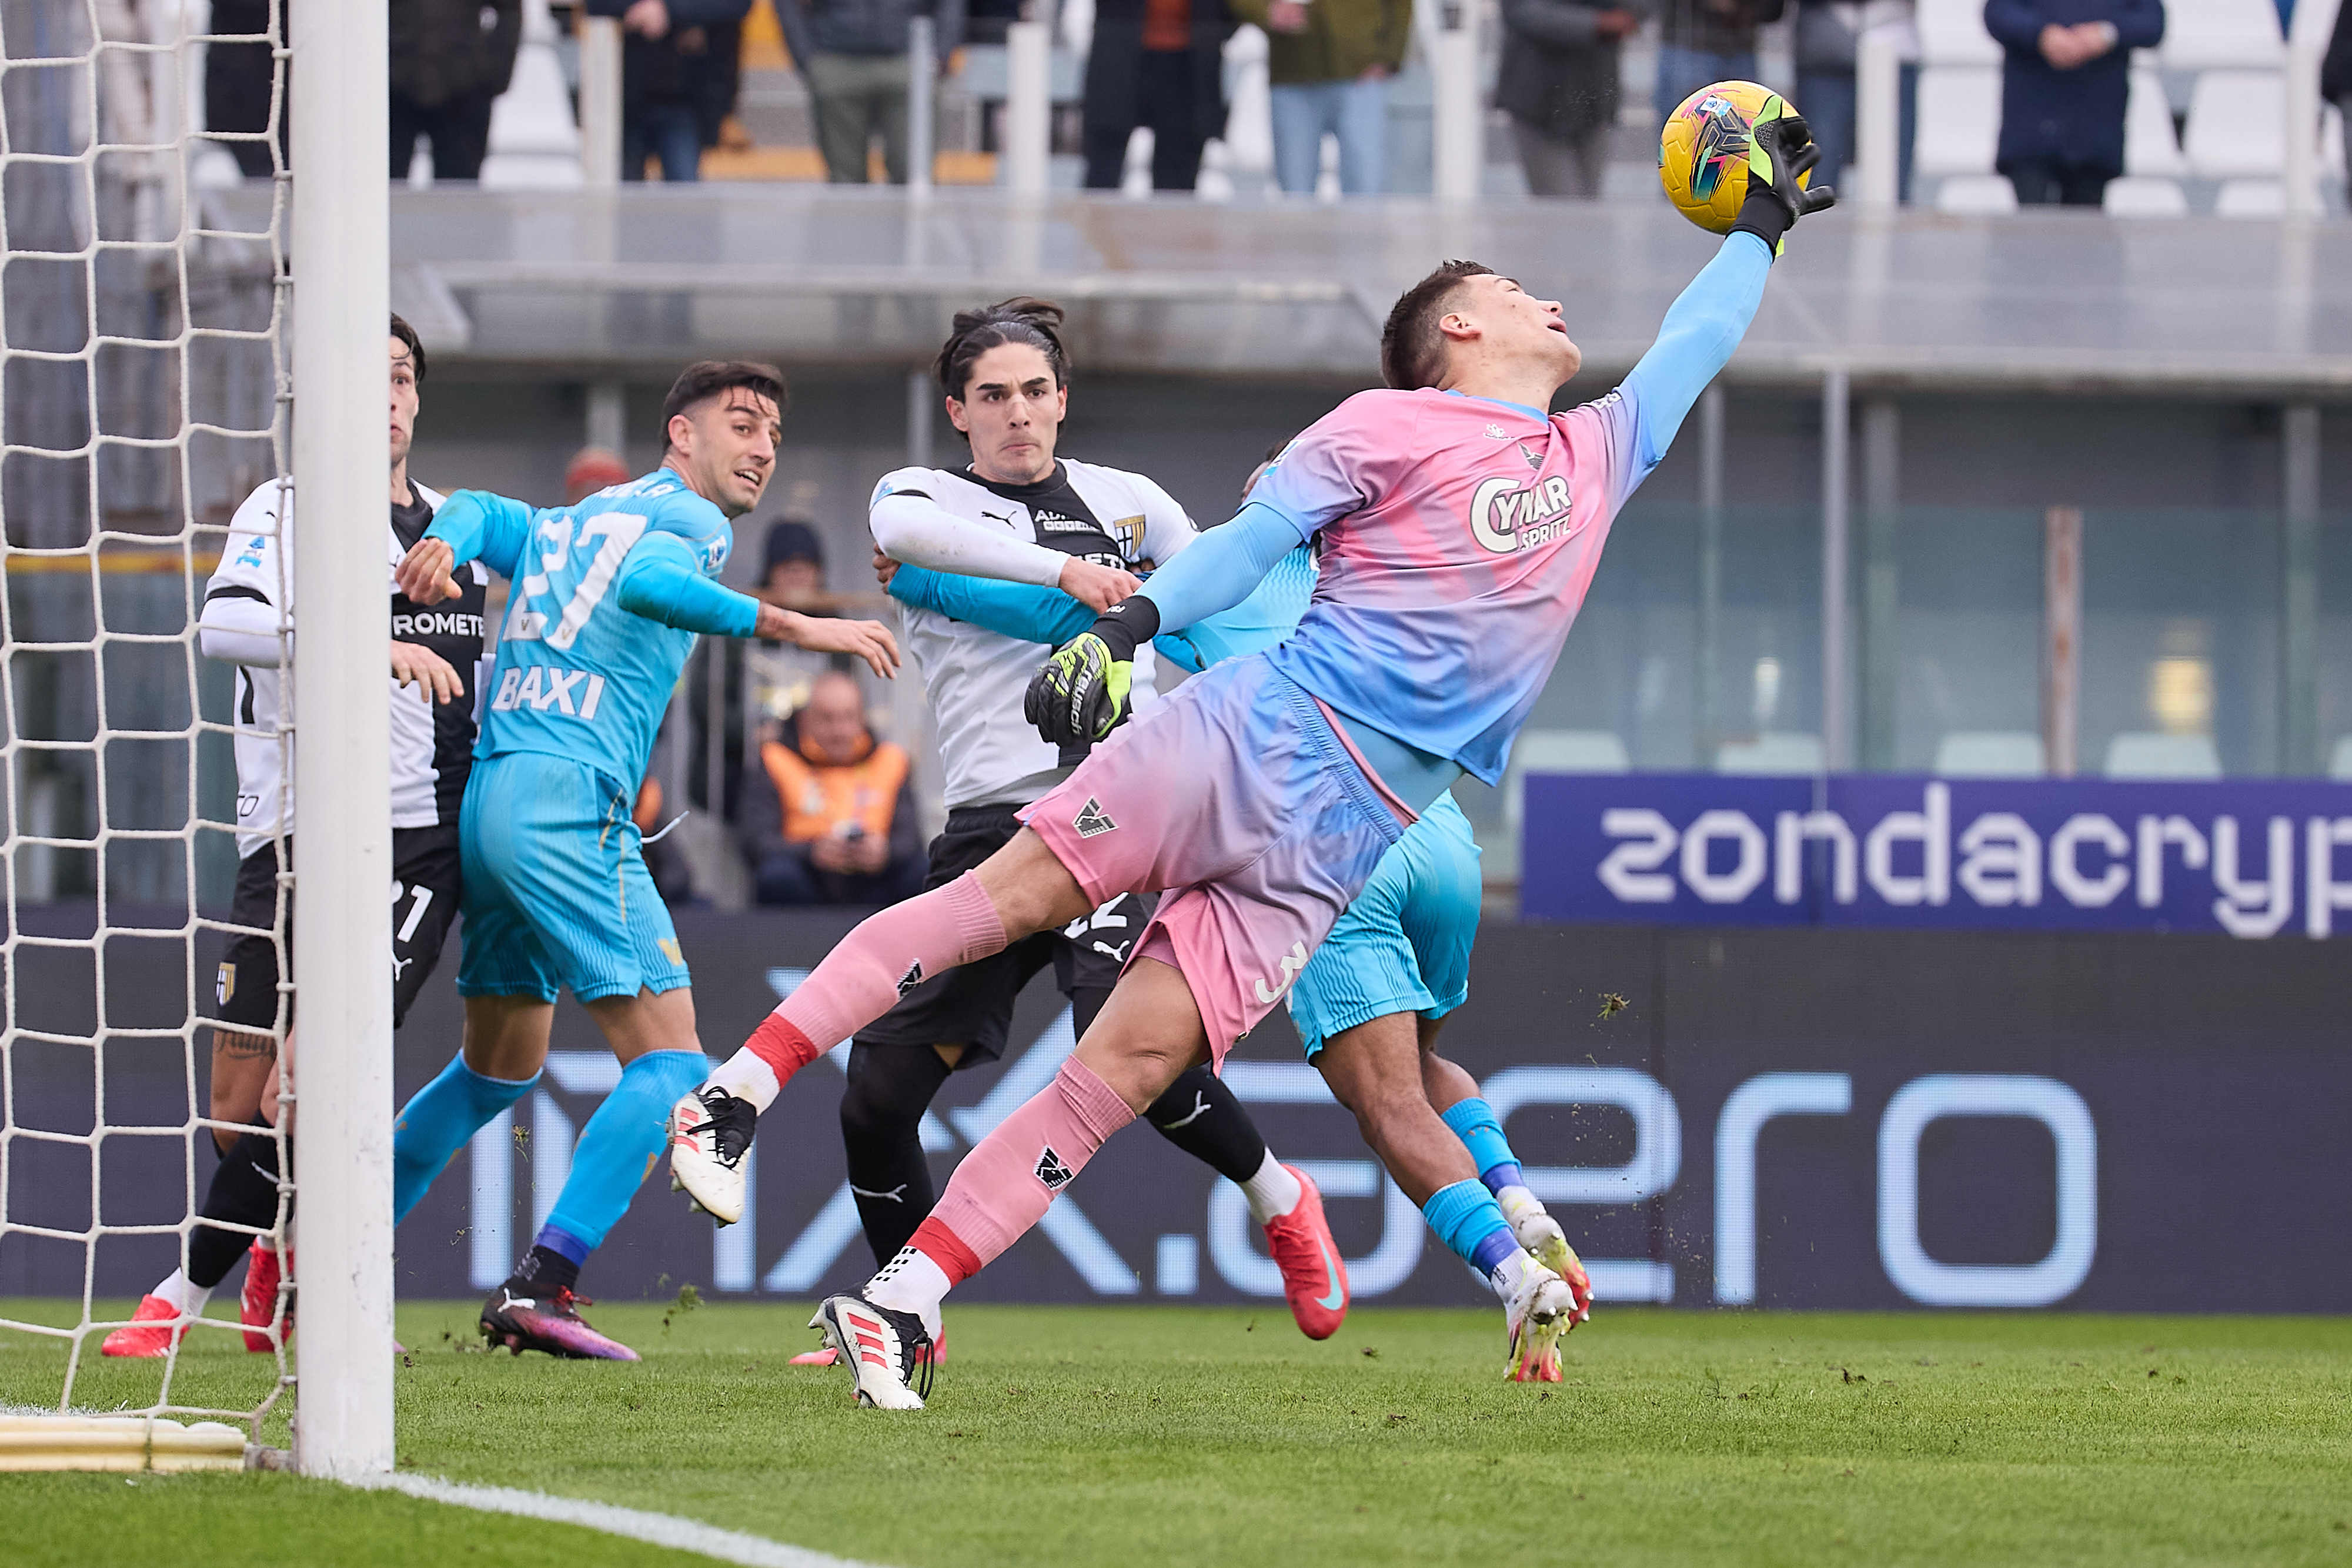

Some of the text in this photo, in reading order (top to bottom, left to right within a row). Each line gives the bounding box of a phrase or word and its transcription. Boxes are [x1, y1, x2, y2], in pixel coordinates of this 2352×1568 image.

[1521, 513, 1572, 551] SPRITZ
[502, 511, 647, 650] 27
[493, 664, 605, 721] BAXI
[1597, 781, 2352, 940] zondacryp
[1254, 940, 1309, 1004] 3
